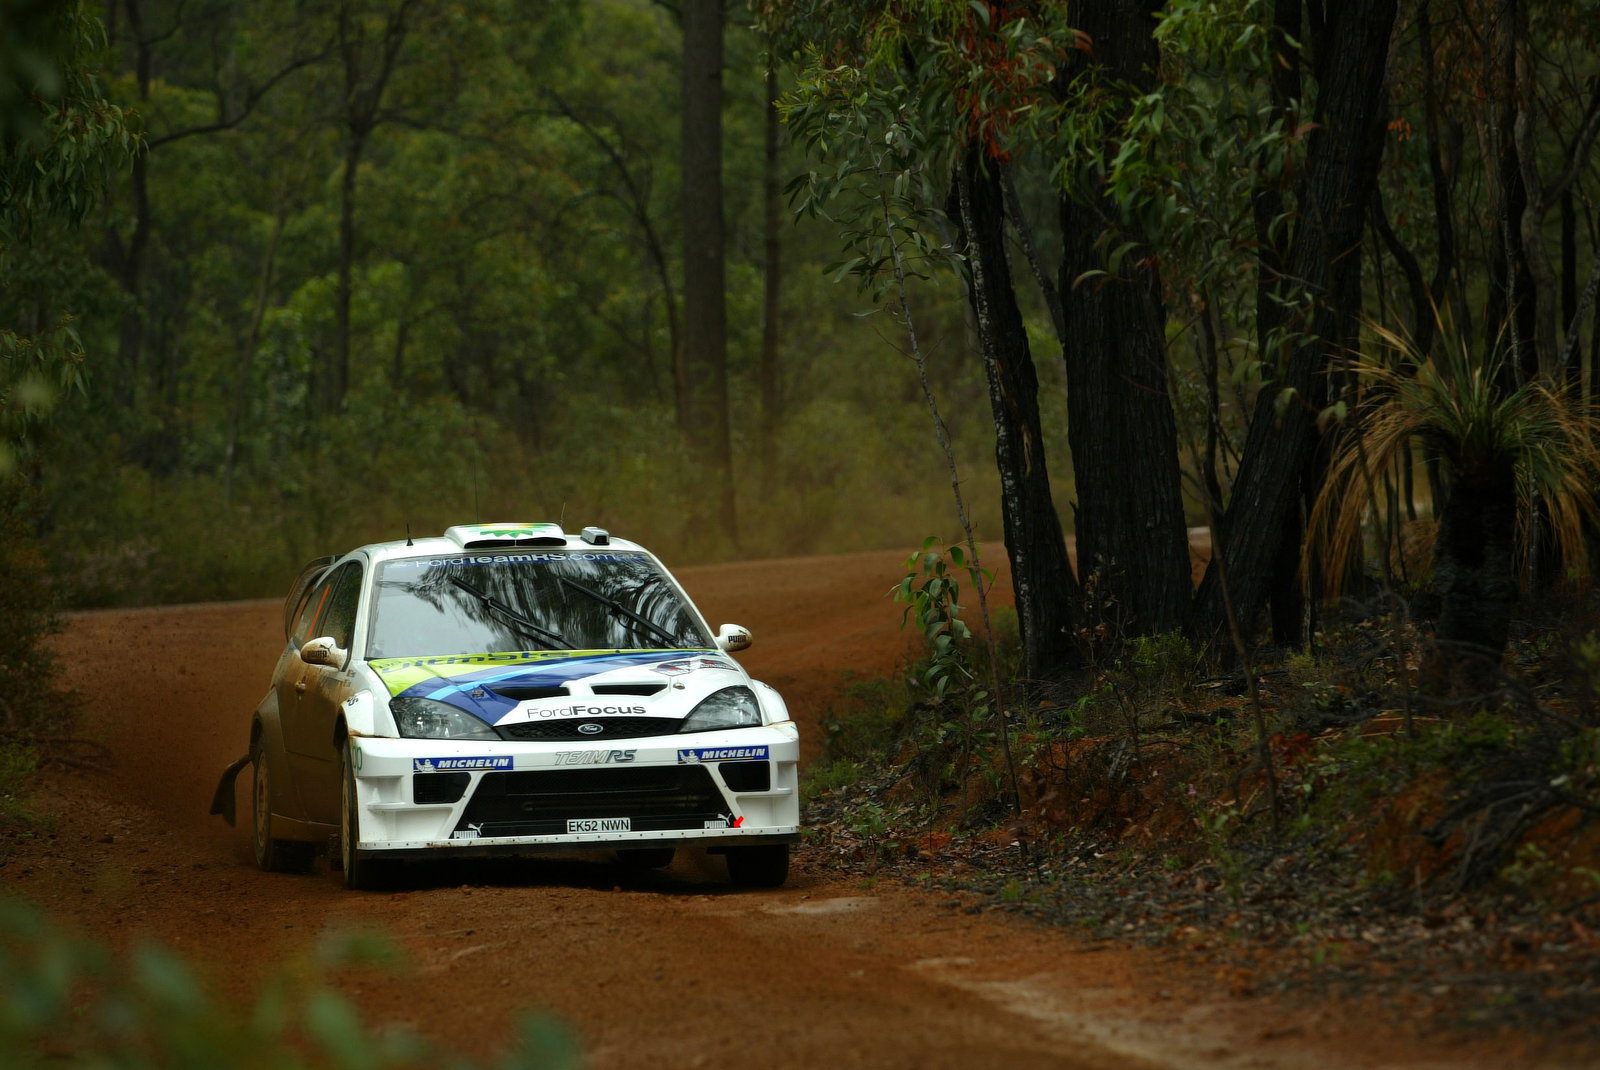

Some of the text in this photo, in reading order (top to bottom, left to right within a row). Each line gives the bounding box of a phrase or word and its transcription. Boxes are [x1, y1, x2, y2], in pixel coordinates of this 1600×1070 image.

[527, 706, 646, 718] FordFocus
[702, 749, 765, 759] MICHELIN
[438, 758, 509, 769] MICHELIN
[568, 819, 629, 832] EK52 NWN
